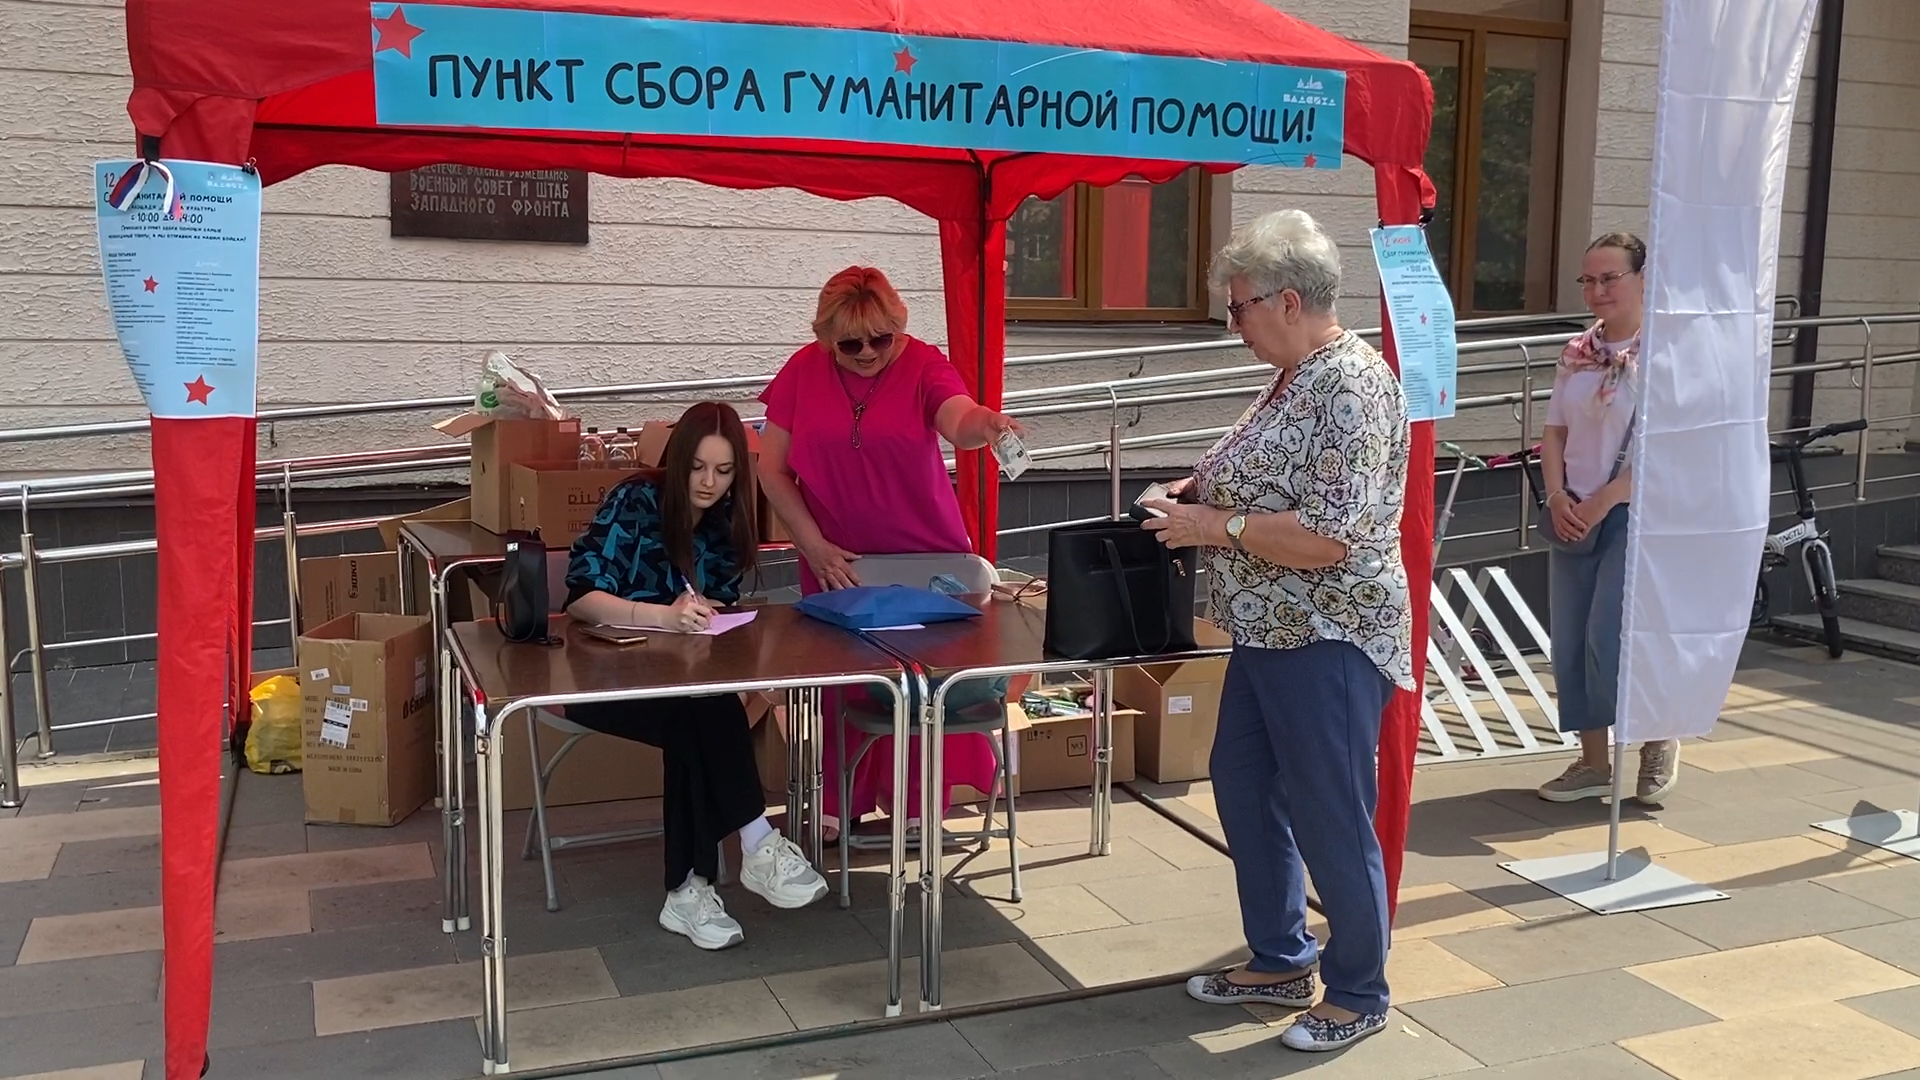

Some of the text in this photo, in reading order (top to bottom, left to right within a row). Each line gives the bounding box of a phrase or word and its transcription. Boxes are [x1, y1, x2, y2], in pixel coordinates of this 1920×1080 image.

[428, 55, 1316, 145] ПУНКТ СБОРА ГУМАНИТАРНОЙ ПОМОЩИ!
[103, 171, 115, 188] 12
[411, 172, 569, 200] ВОЕННЫЙ СОВЕТ И ШТАБ
[190, 194, 233, 204] ПОМОЩИ
[410, 192, 570, 218] ЗАПАДНОГО ФРОНТА
[137, 212, 160, 222] 10:00
